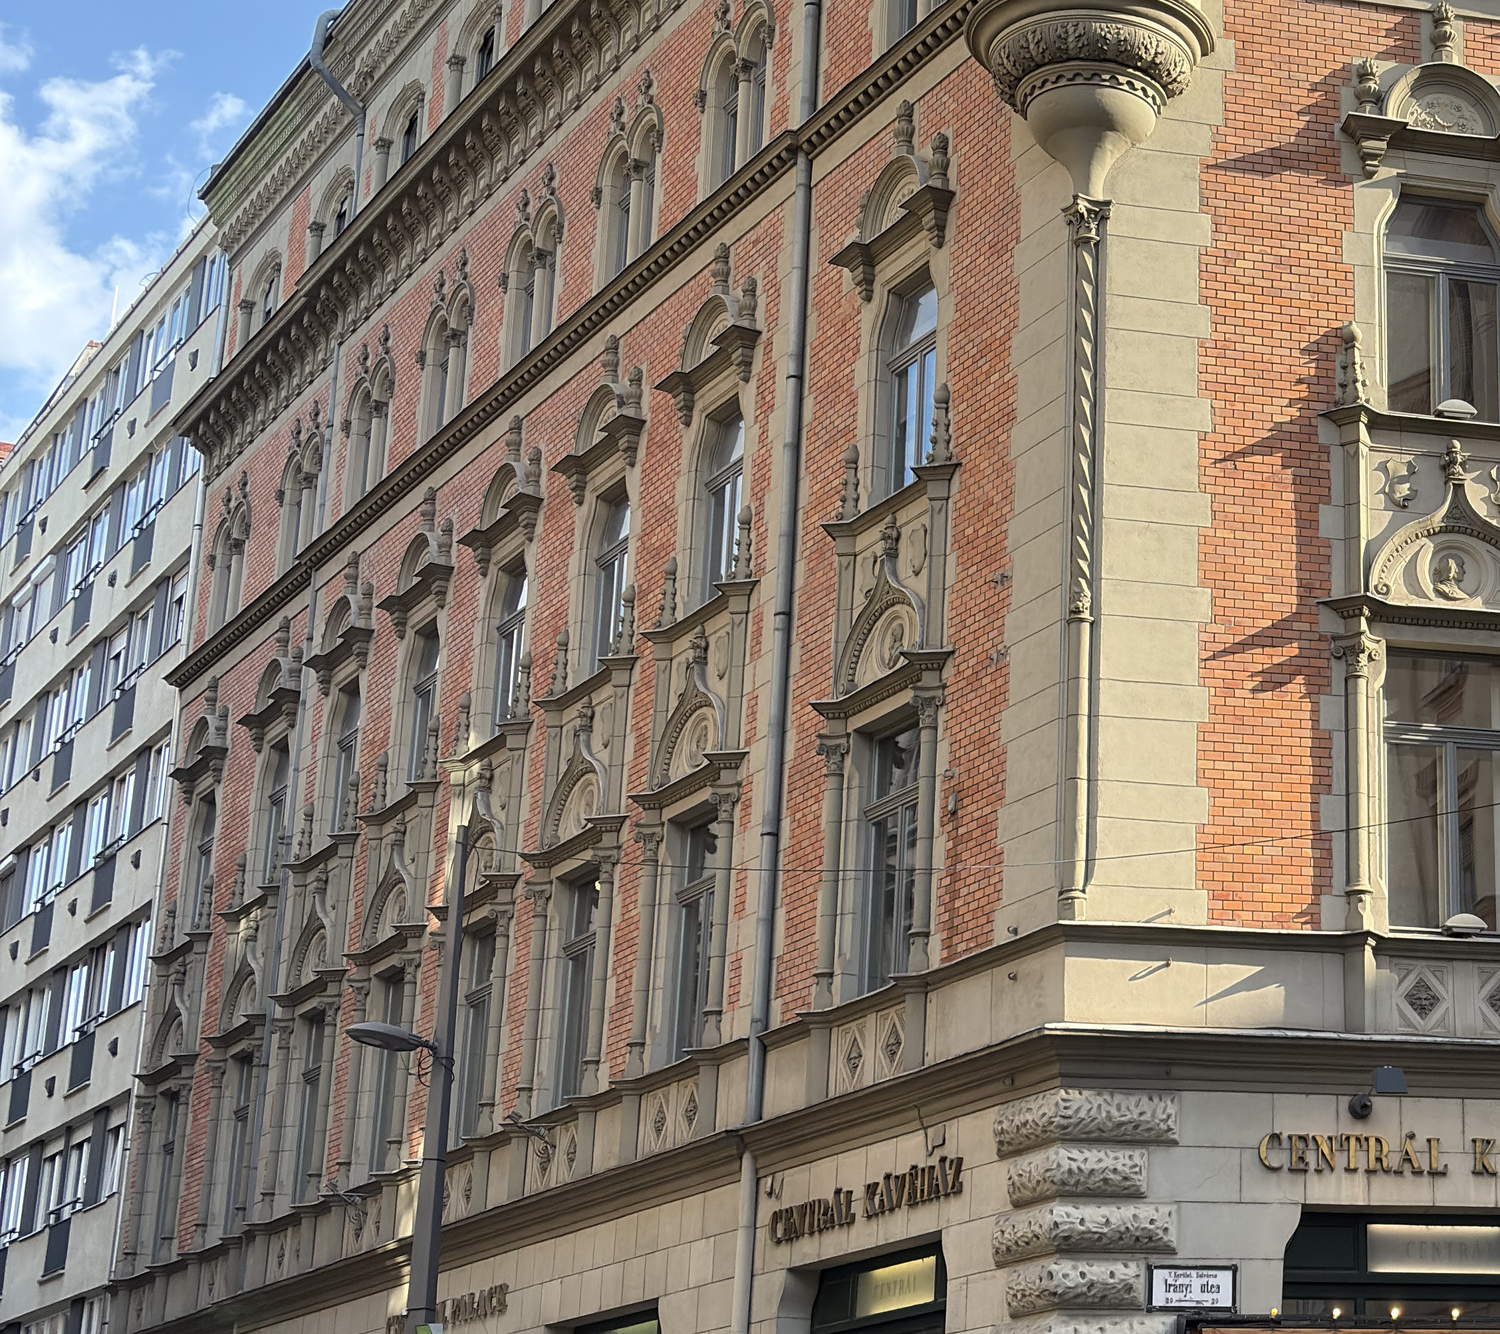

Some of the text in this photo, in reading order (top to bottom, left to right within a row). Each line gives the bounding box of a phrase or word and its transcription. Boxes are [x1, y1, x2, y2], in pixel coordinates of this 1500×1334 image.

[1258, 1131, 1448, 1175] CENTRÁL
[768, 1156, 963, 1243] CENTRÁL KÁVÉHÁZ
[1164, 1279, 1220, 1298] Irányi utca
